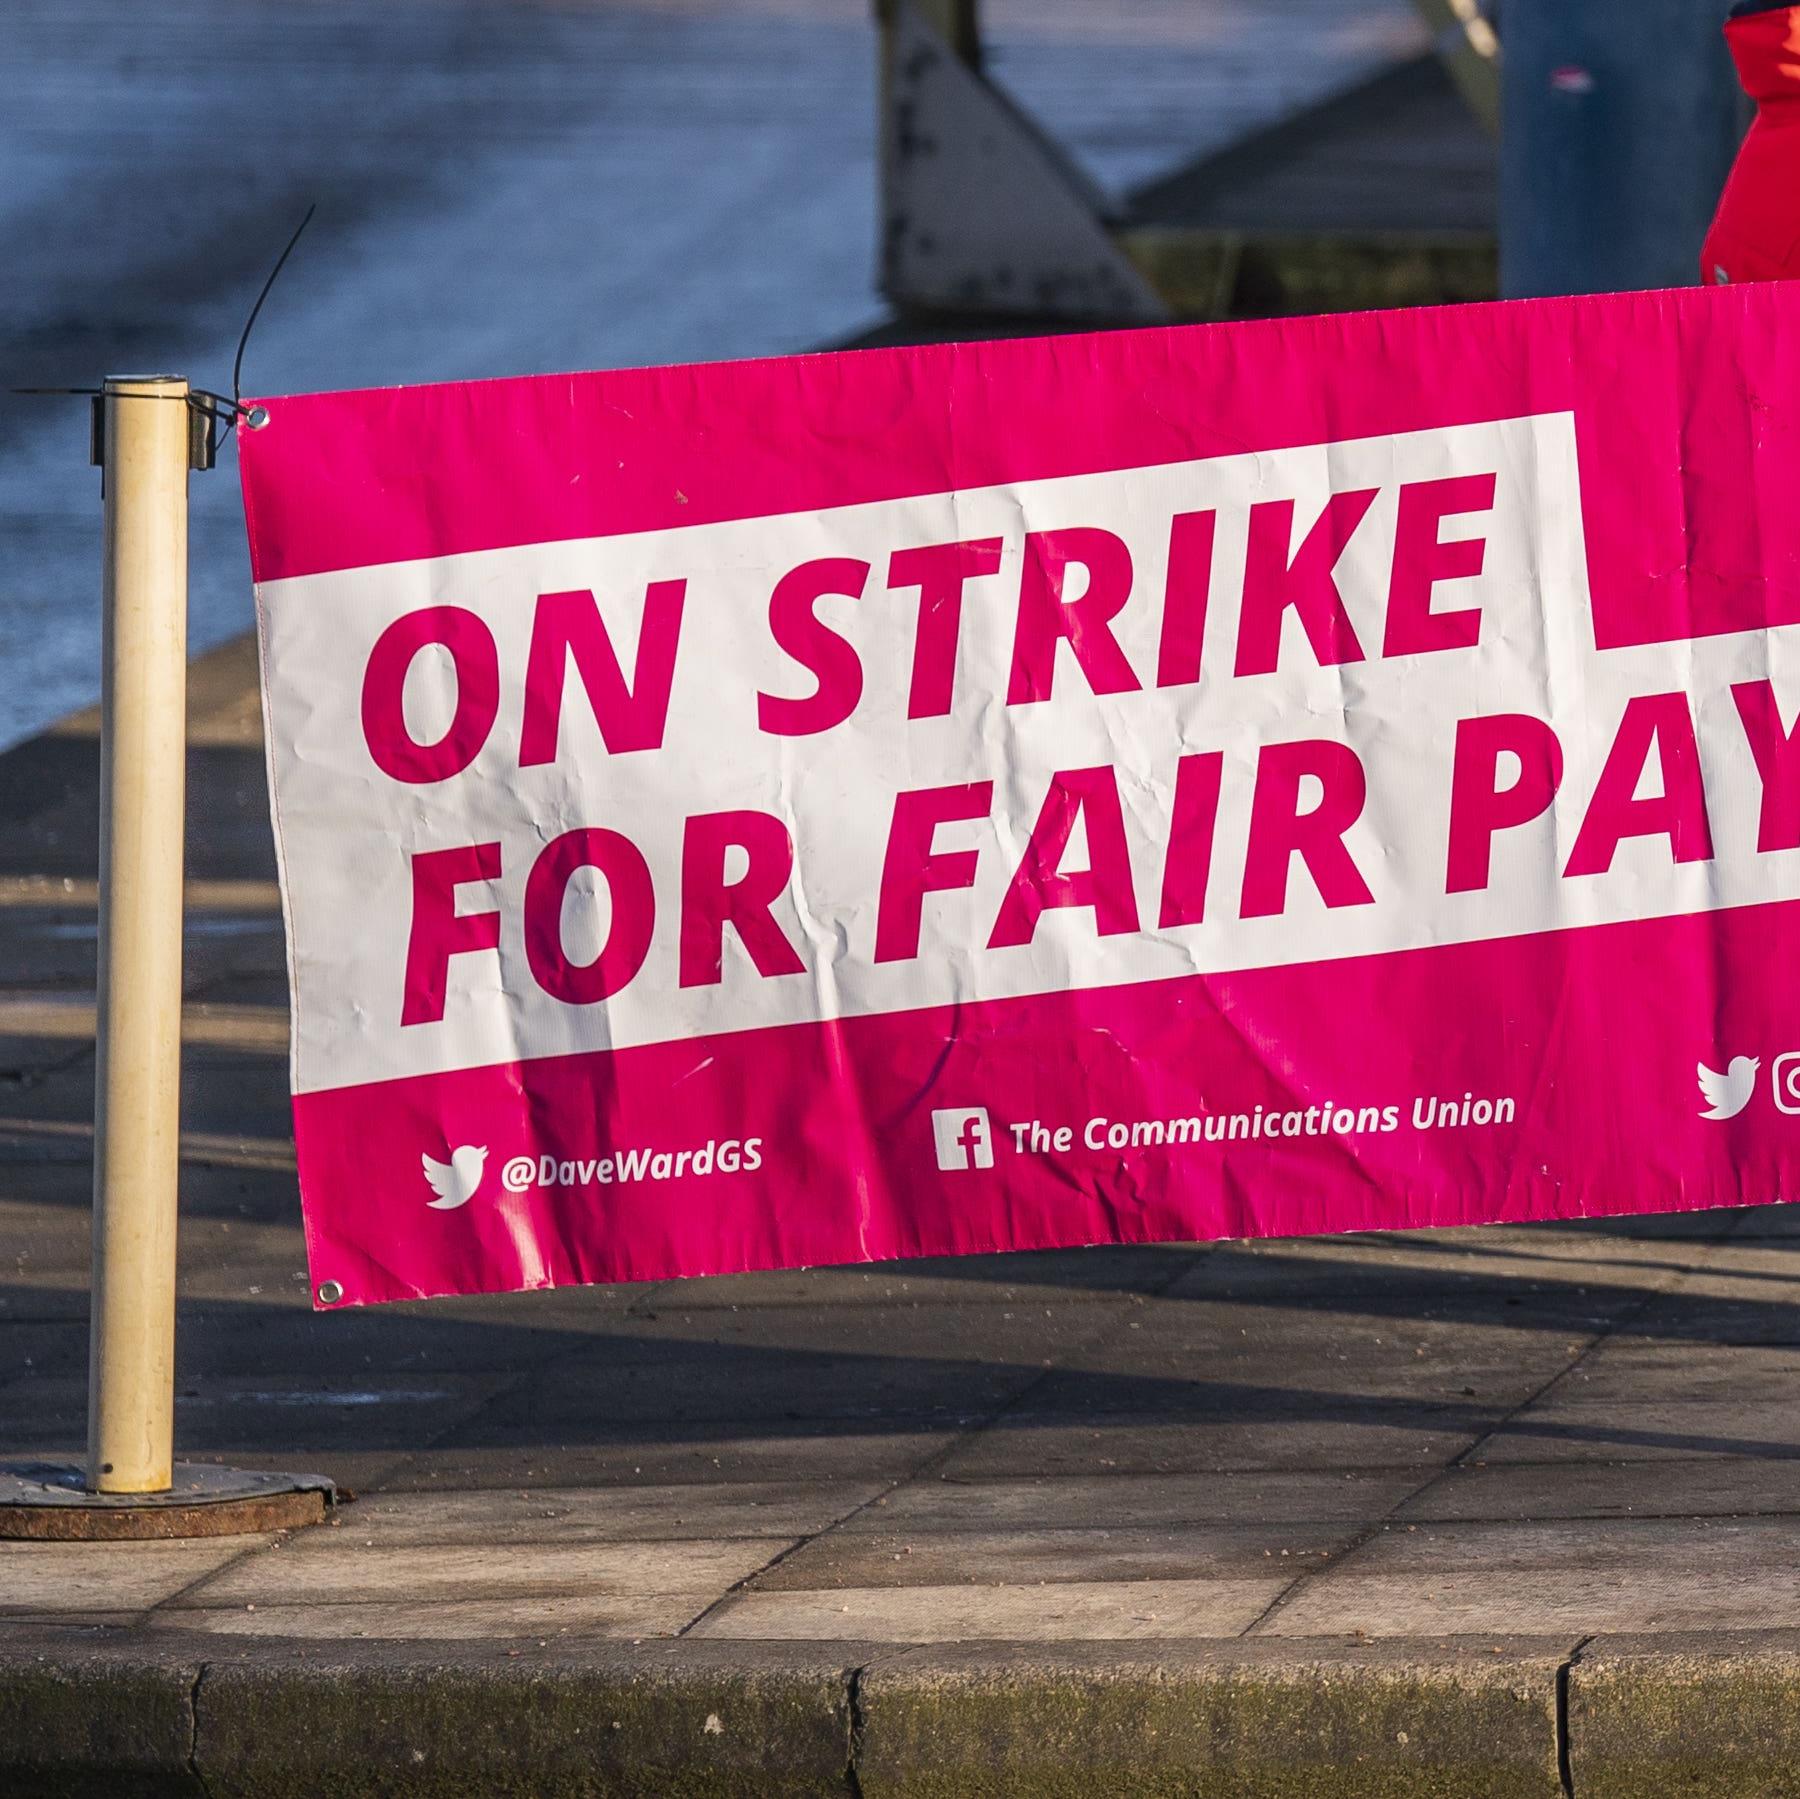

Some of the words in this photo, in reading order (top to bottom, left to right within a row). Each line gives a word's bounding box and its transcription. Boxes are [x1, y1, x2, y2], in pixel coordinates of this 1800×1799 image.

[362, 578, 688, 785] ON
[757, 472, 1497, 737] STRIKE
[400, 809, 808, 1027] FOR
[873, 713, 1376, 964] FAIR
[501, 1138, 762, 1193] @DaveWardGS
[1009, 1120, 1073, 1154] The
[1084, 1104, 1400, 1150] Communications
[1412, 1092, 1515, 1130] Union
